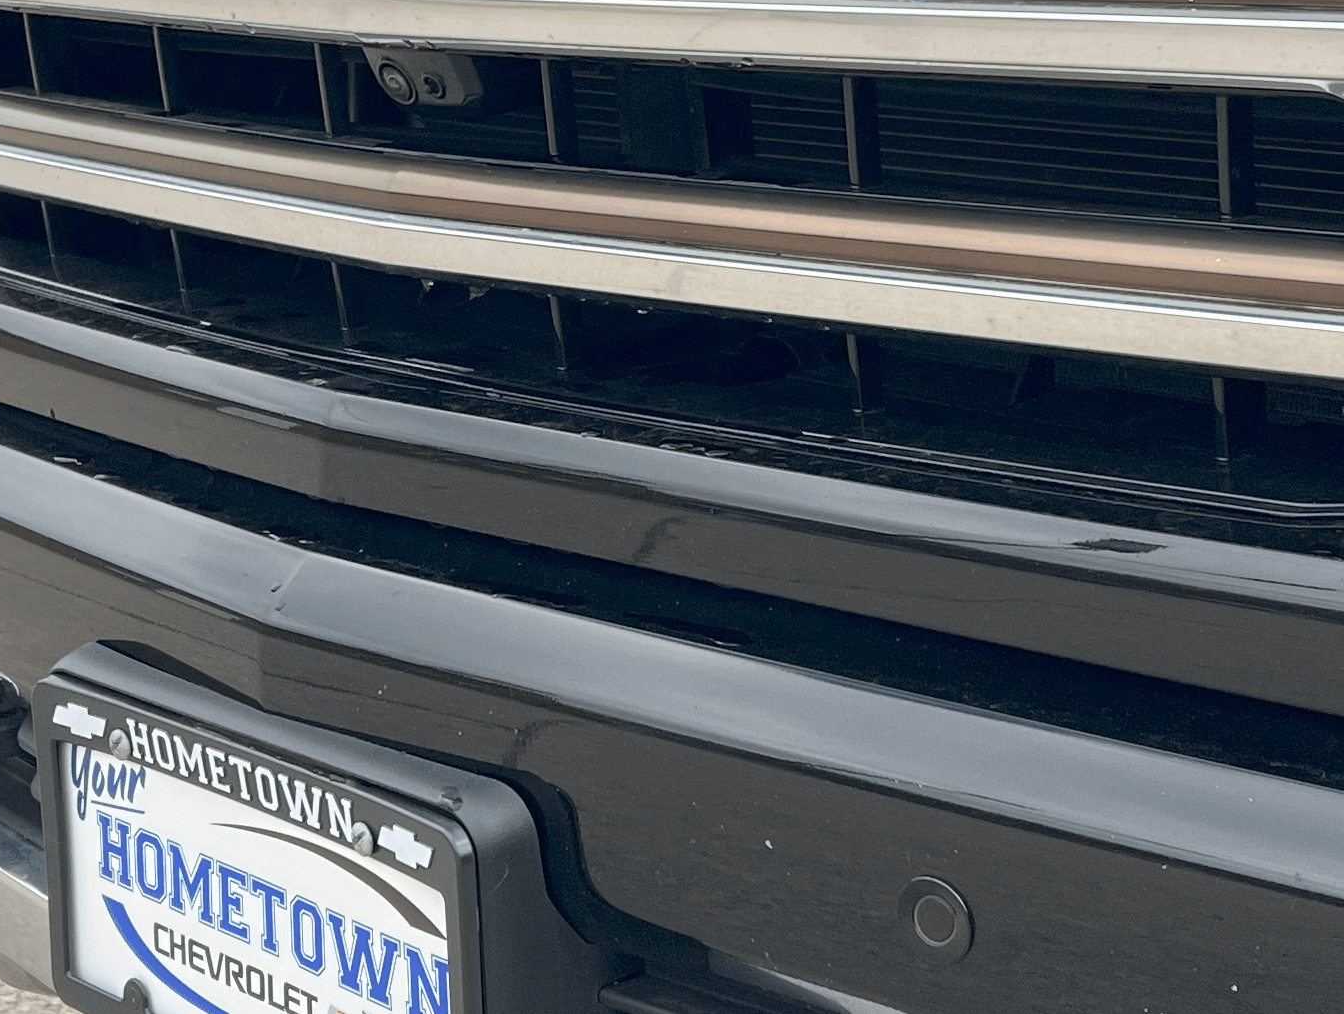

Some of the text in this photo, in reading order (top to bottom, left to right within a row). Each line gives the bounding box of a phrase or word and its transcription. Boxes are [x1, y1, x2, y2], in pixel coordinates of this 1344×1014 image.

[125, 718, 355, 842] HOMETOWN
[96, 809, 450, 1014] HOMETOWN
[154, 922, 318, 1014] CHEVROLET
